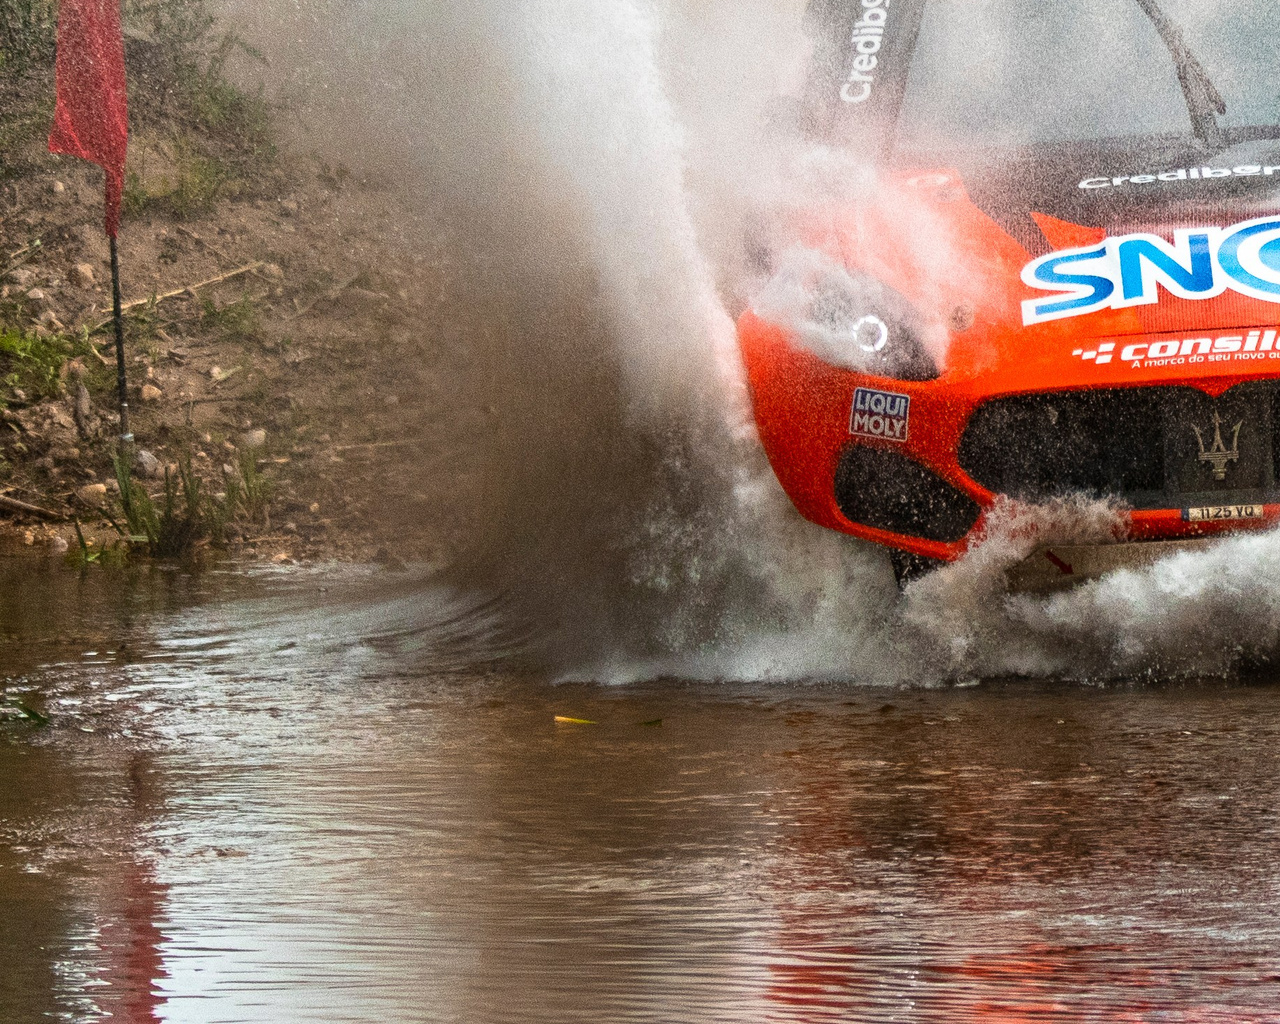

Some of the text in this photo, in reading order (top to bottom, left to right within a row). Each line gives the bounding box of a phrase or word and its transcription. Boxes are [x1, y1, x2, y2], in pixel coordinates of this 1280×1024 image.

[1131, 360, 1141, 369] A
[1144, 357, 1185, 367] marca
[1188, 354, 1205, 364] do
[1207, 353, 1231, 363] seu
[1234, 352, 1265, 360] novo
[856, 391, 906, 417] LIQUI
[853, 412, 905, 438] MOLY
